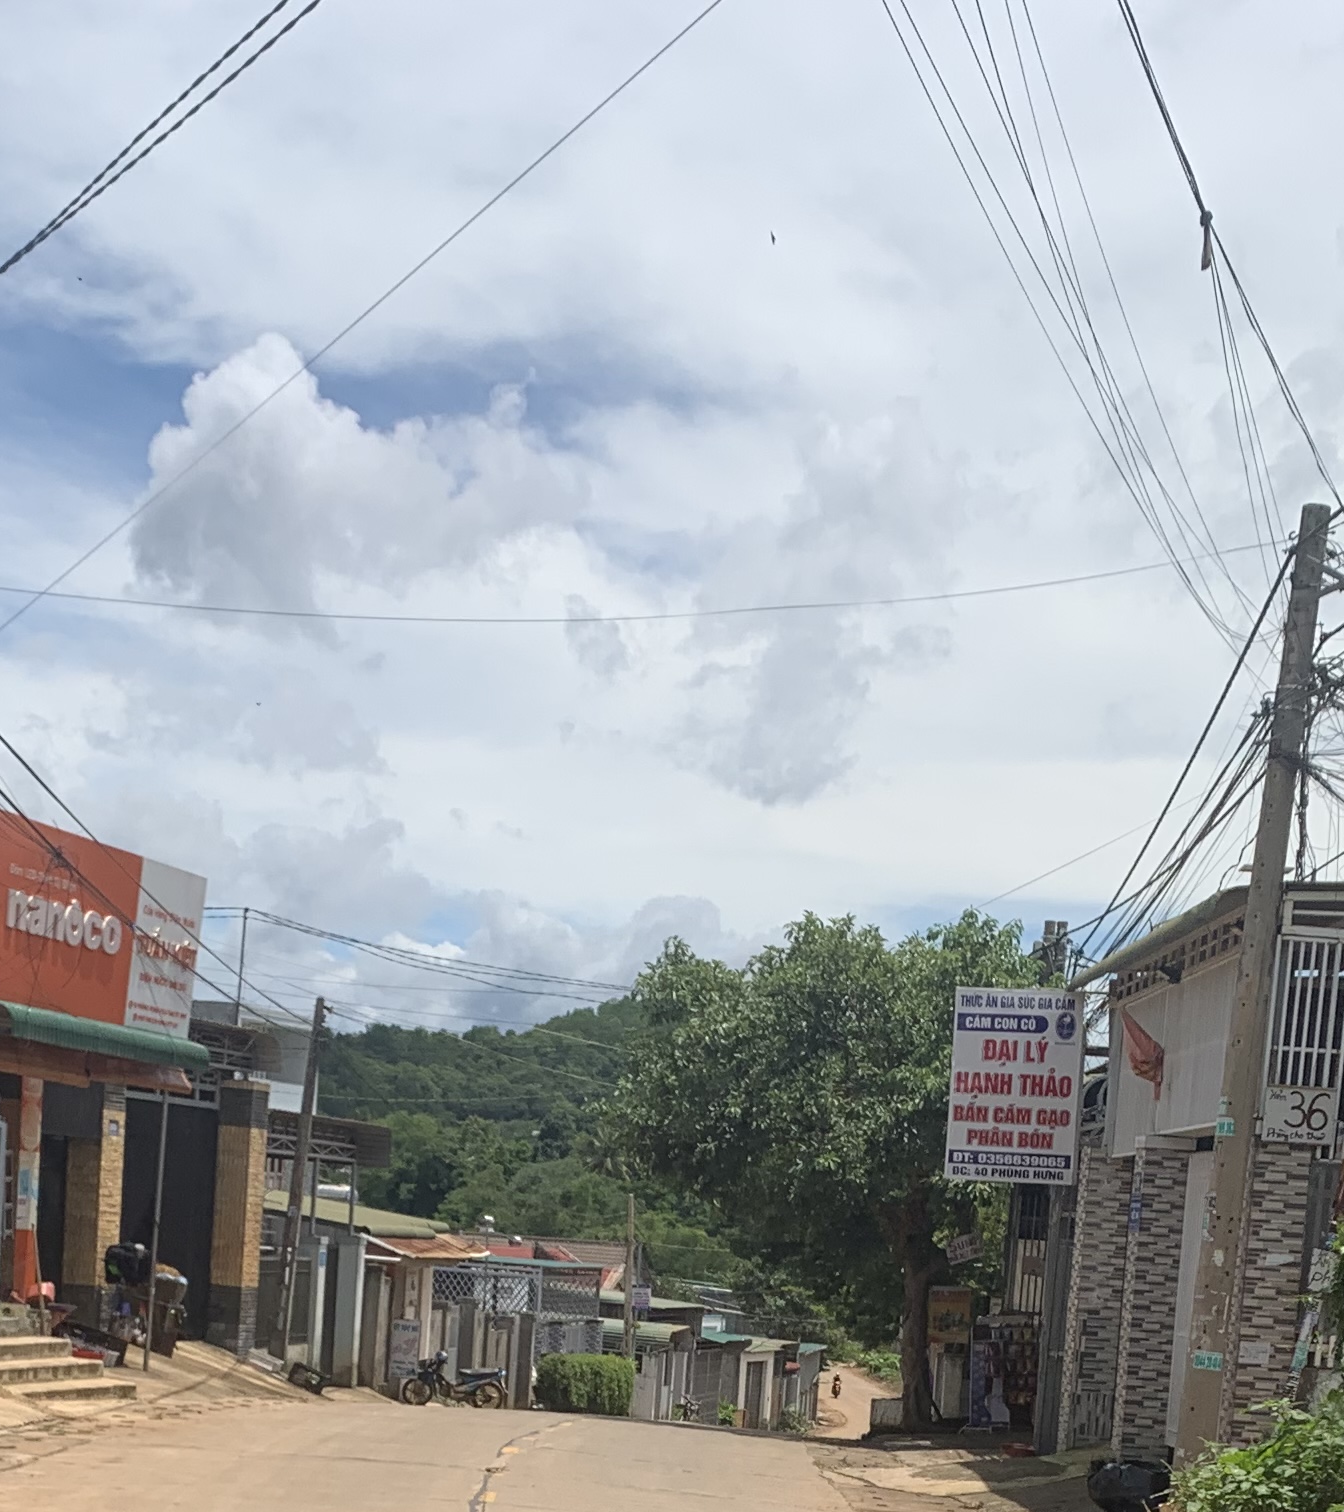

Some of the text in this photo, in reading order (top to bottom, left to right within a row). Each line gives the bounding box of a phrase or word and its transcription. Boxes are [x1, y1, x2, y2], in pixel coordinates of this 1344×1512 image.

[960, 993, 983, 1008] THỨC
[1000, 995, 1015, 1009] GIA
[1017, 994, 1036, 1010] SÚC
[1037, 997, 1053, 1010] GIA
[994, 1017, 1017, 1030] CON
[982, 1036, 1049, 1067] ĐẠI LÝ
[954, 1067, 1072, 1099] HẠNH THẢO
[1036, 1108, 1071, 1130] GẠO
[1284, 1090, 1331, 1131] 36
[966, 1126, 1054, 1150] PHÂN BÓN
[1290, 1130, 1304, 1140] cho
[952, 1151, 974, 1163] ĐT:
[974, 1167, 988, 1177] 40
[991, 1166, 1030, 1179] PHÙNG
[1033, 1169, 1064, 1181] HƯNG
